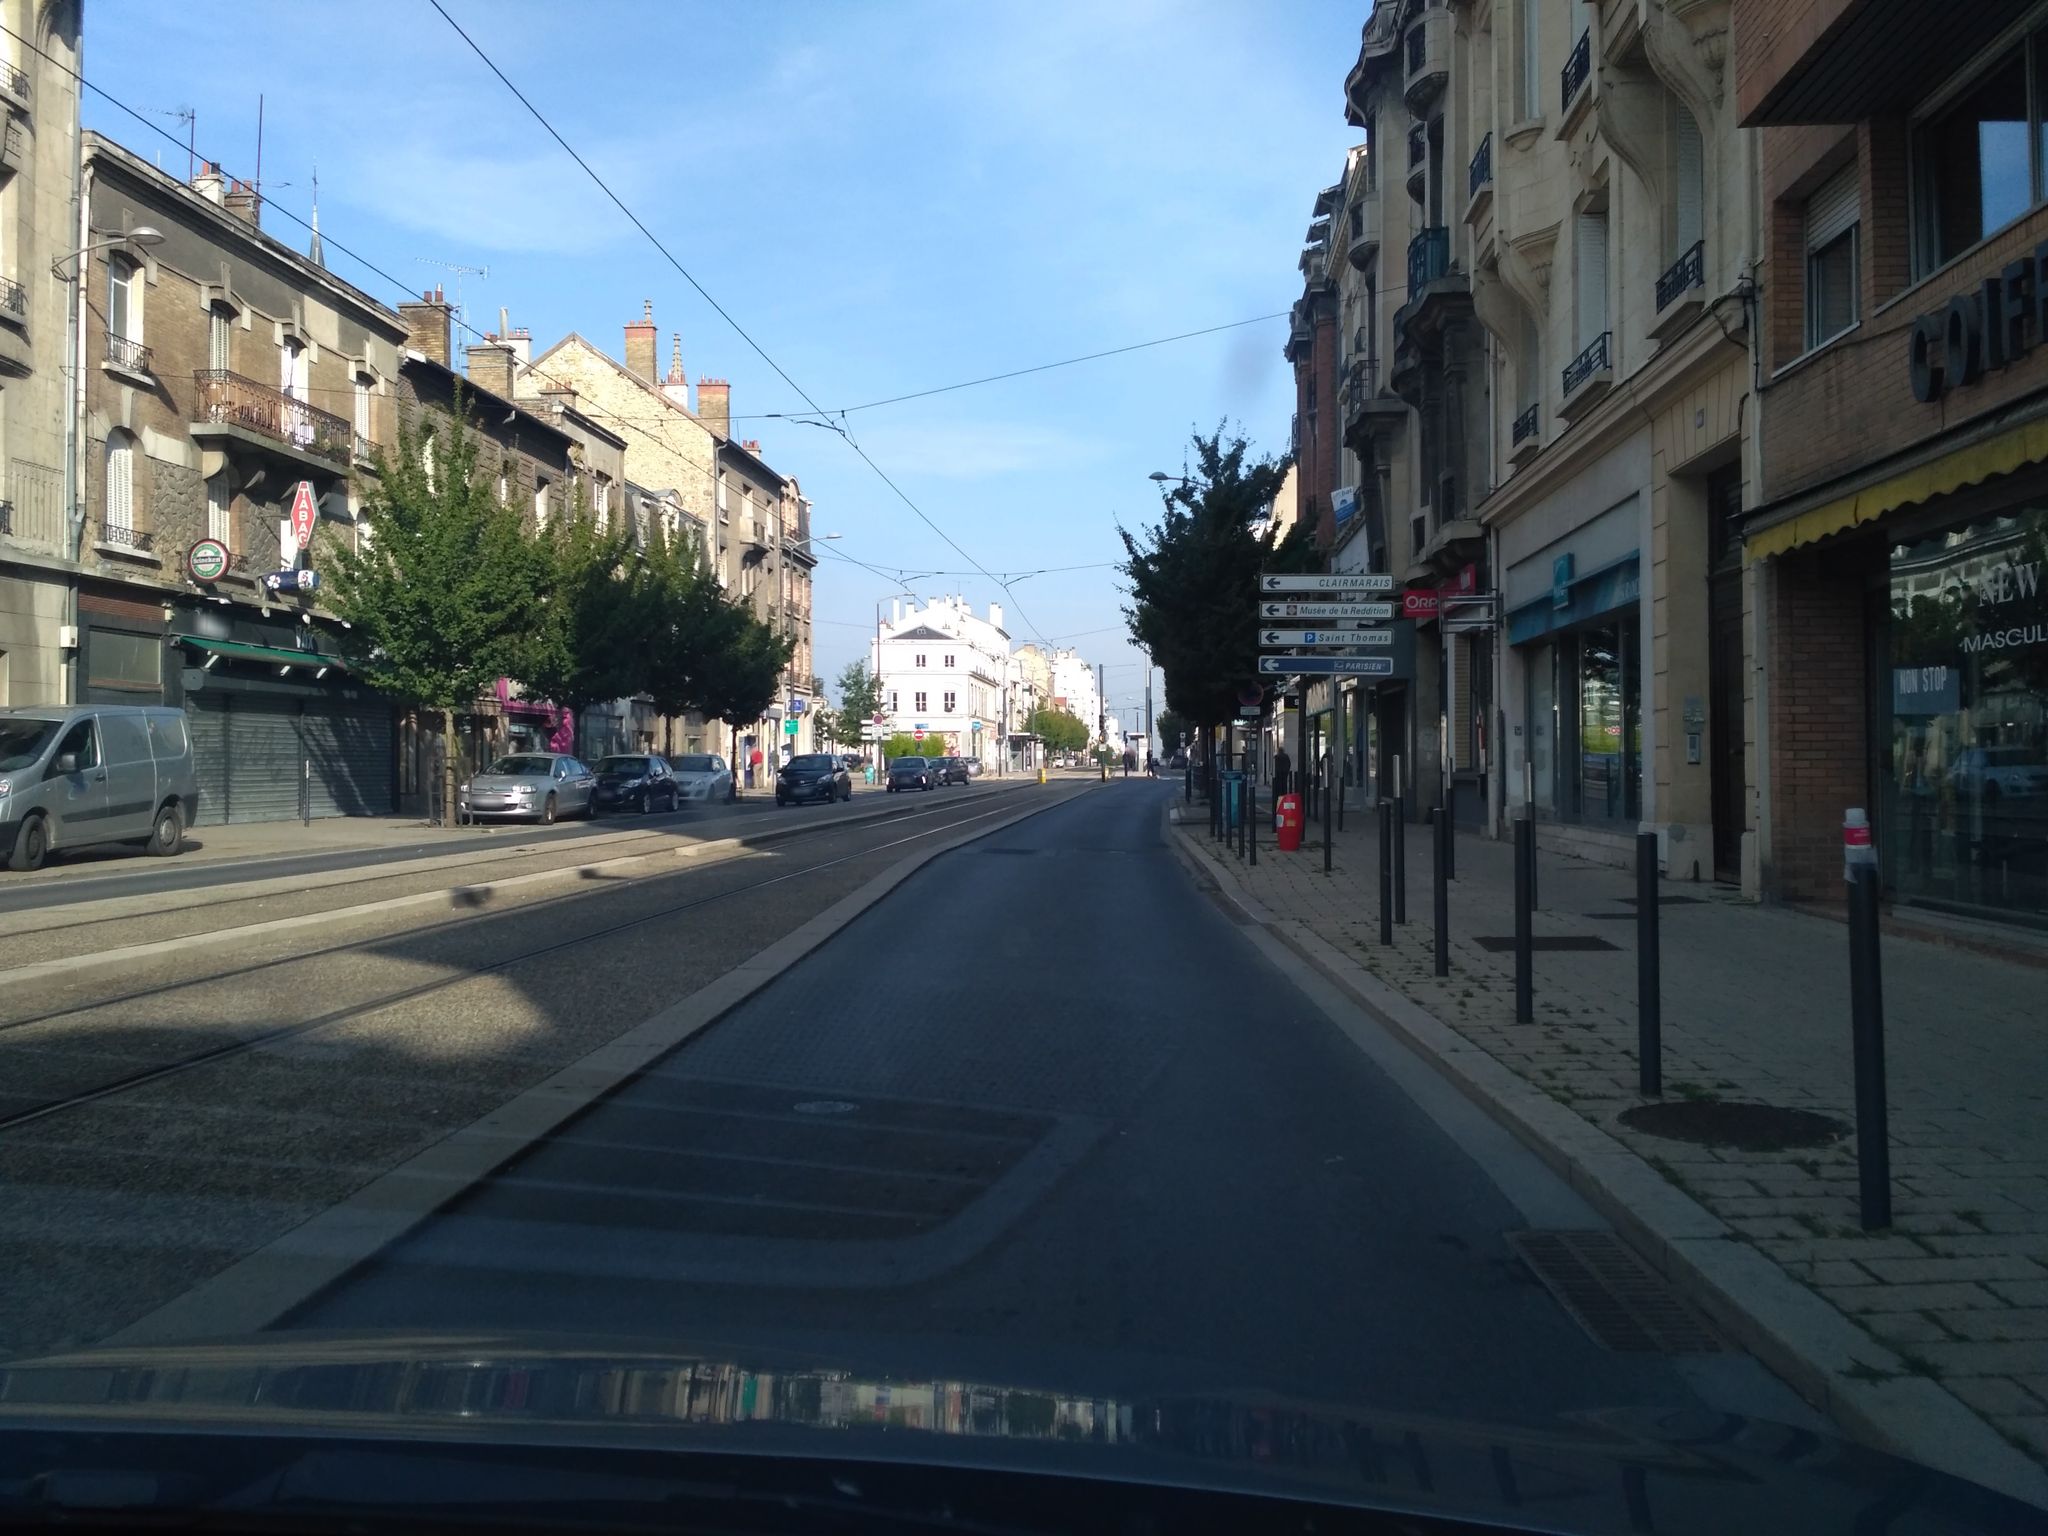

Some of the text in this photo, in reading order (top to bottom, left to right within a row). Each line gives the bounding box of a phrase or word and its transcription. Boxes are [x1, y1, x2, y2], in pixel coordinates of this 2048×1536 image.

[298, 488, 309, 544] TABAC
[1318, 578, 1390, 588] CLAIRMARAIS
[1977, 560, 2042, 607] NEW
[1406, 595, 1439, 609] ORP
[1300, 605, 1389, 615] Musée de la Reddition
[1306, 633, 1389, 642] P Saint Thomas
[1345, 662, 1382, 670] PARISIEN
[1899, 665, 1947, 694] NON STOP
